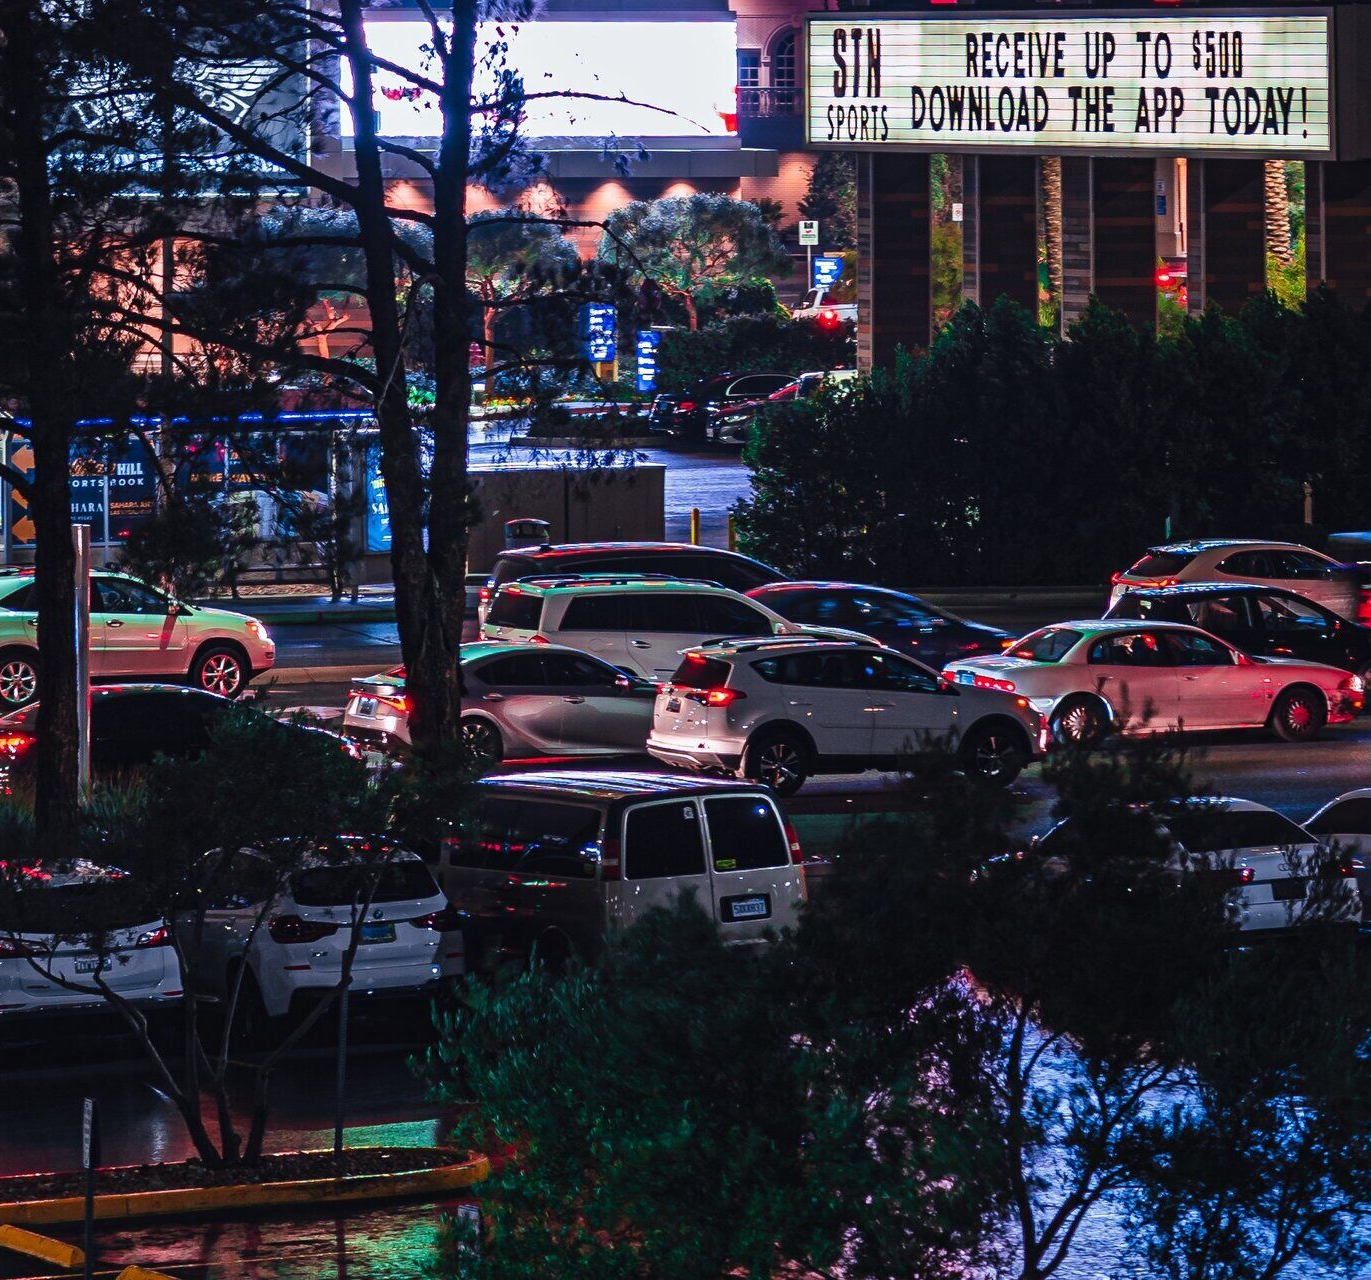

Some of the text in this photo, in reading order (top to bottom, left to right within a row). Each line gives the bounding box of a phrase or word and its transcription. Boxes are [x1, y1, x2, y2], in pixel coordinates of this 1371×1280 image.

[833, 27, 881, 98] STN
[966, 29, 1243, 78] RECEIVE UP TO $500
[827, 104, 889, 141] SPORTS
[911, 85, 1308, 140] DOWNLOAD THE APP TODAY!
[71, 479, 105, 487] ORTS
[116, 462, 144, 476] HILL
[70, 502, 104, 513] HARA
